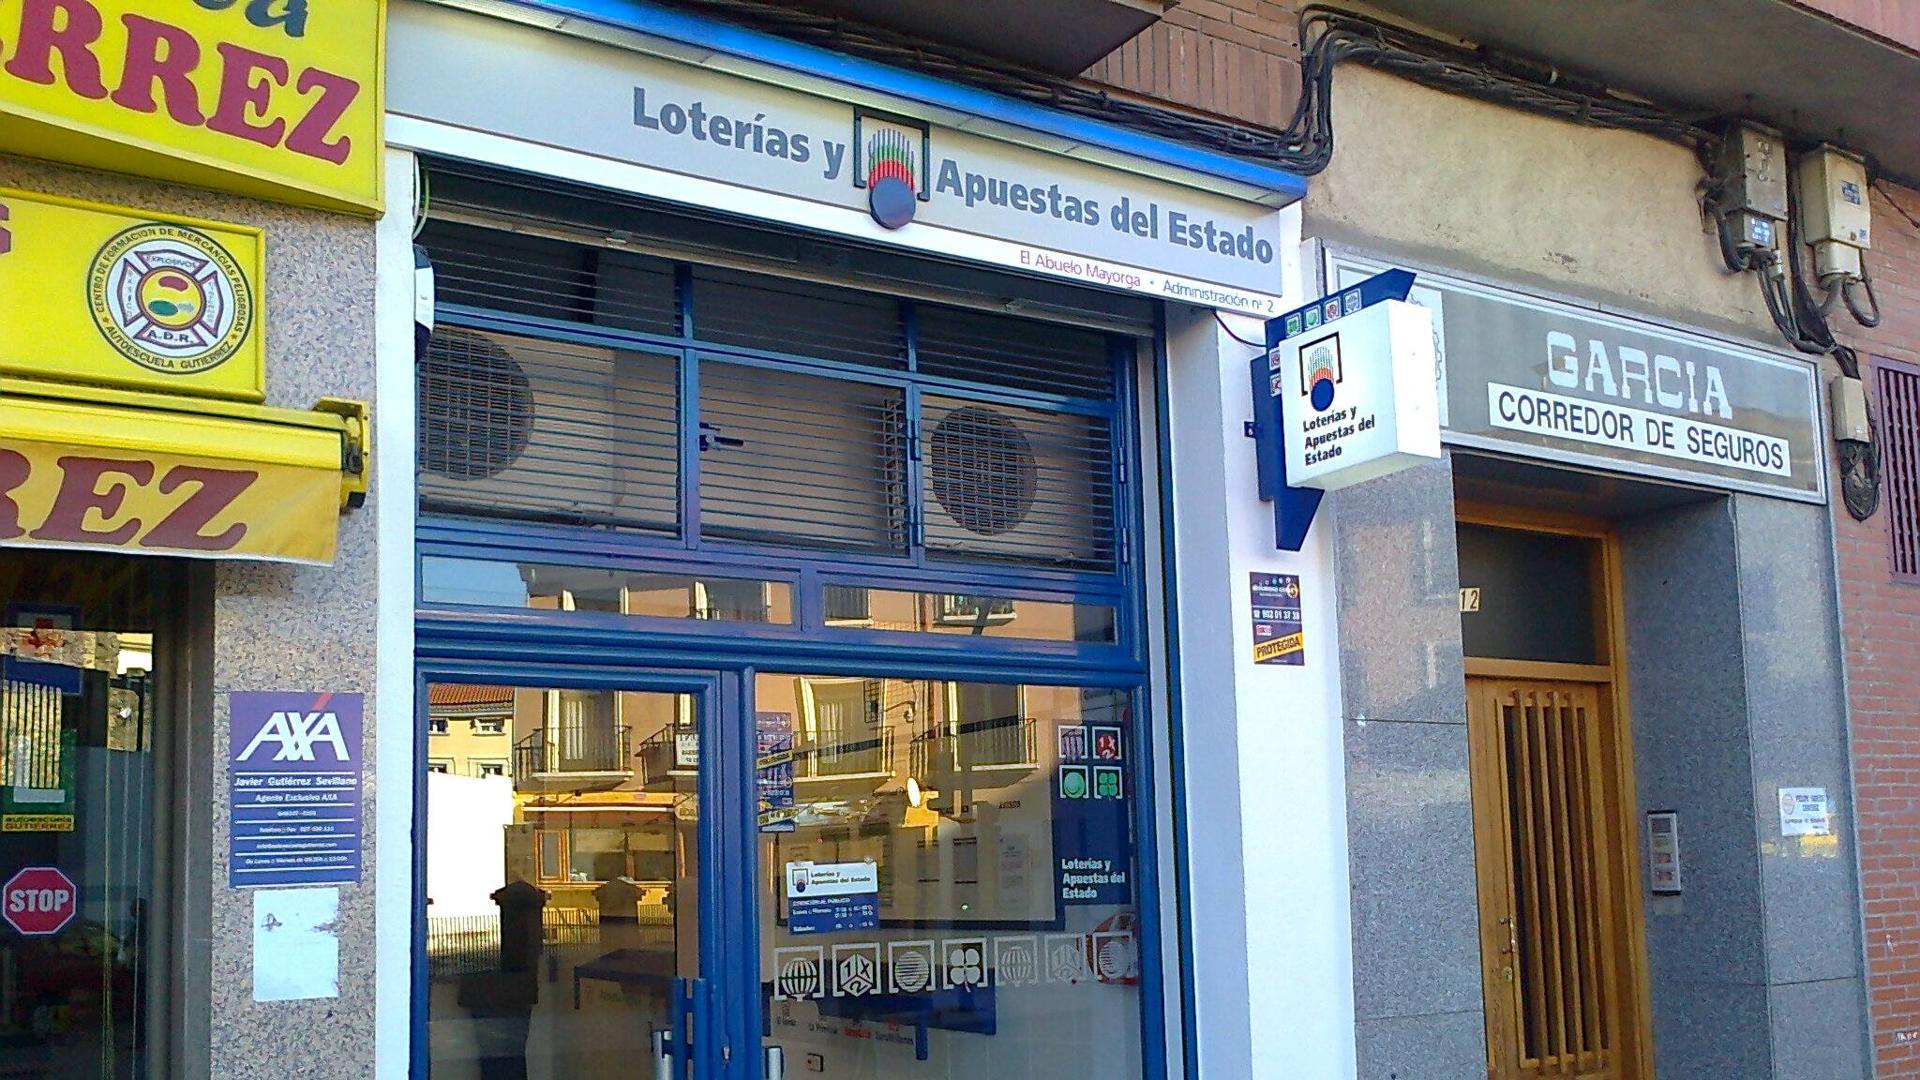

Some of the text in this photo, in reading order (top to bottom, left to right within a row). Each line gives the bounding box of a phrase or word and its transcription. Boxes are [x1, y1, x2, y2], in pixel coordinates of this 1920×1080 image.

[633, 86, 1274, 265] Loterías y Apuestas del Estado
[93, 277, 103, 313] CENTRO
[98, 264, 107, 275] DE
[159, 227, 174, 236] DE
[232, 276, 246, 333] PELIGROSAS
[1020, 249, 1031, 265] El
[1035, 253, 1083, 276] Abuelo
[1085, 263, 1142, 289] Mayorga
[1267, 300, 1274, 313] 2
[105, 325, 234, 369] AUTOESCUELA GUTIERREZ
[149, 329, 194, 344] A.D.R.
[1545, 330, 1733, 420] GARCIA
[1349, 405, 1357, 421] y
[1304, 414, 1376, 451] Apuestas del
[1498, 390, 1785, 470] CORREDOR DE SEGUROS
[1304, 444, 1343, 467] Estado
[0, 447, 260, 551] EZ
[1461, 589, 1478, 610] 12
[235, 711, 351, 761] AXA
[234, 777, 263, 787] Javier
[315, 776, 358, 786] Sevillano
[1062, 871, 1126, 888] Apuestas del
[1104, 860, 1112, 872] y
[9, 889, 70, 912] STOP
[1062, 887, 1098, 899] Estado
